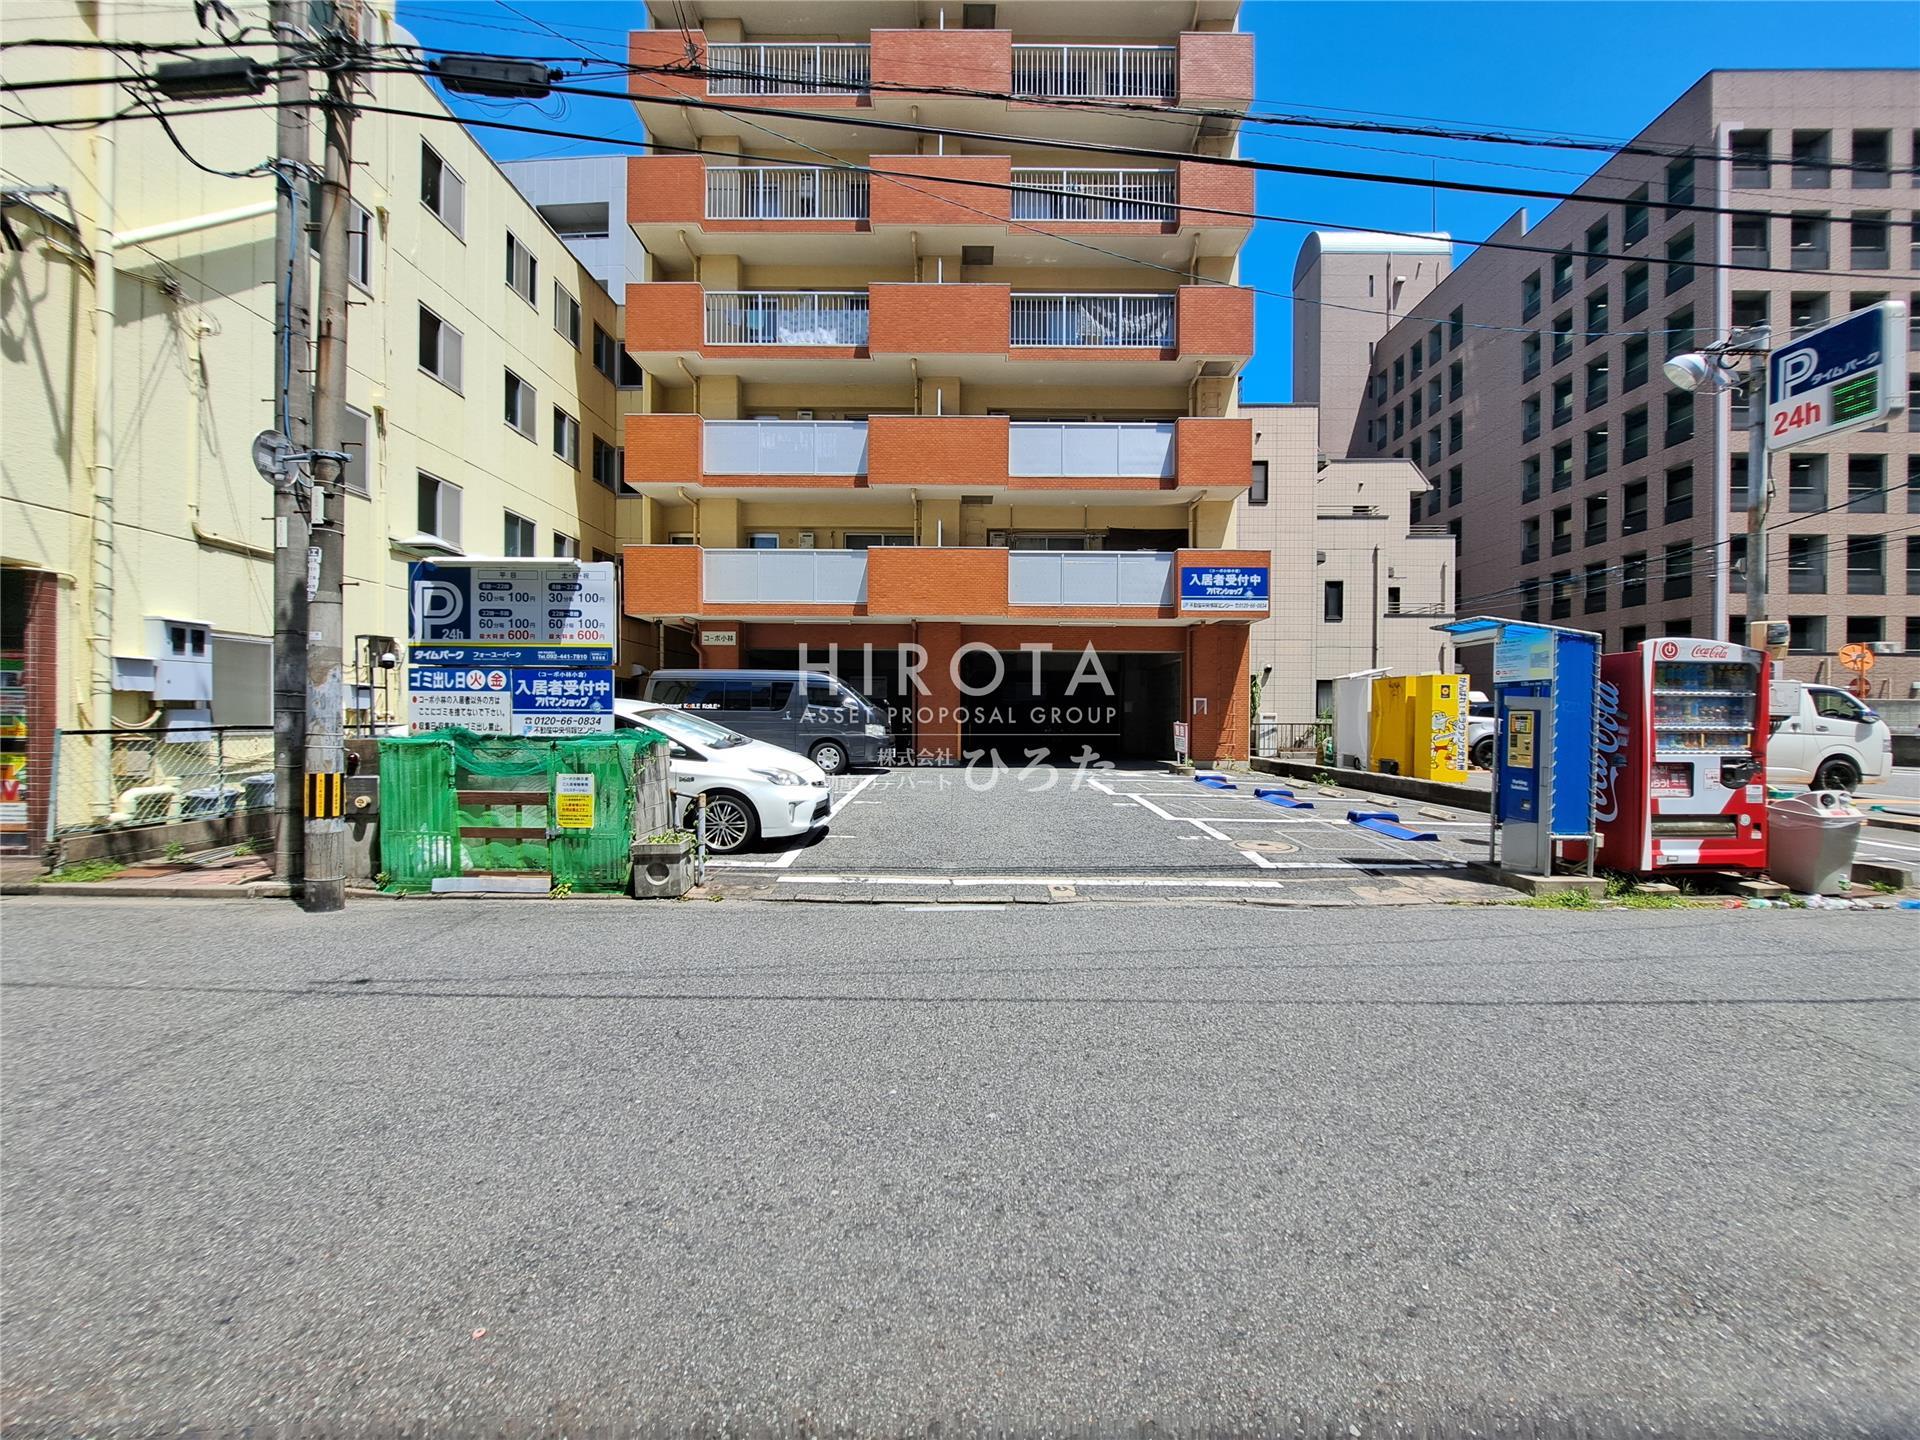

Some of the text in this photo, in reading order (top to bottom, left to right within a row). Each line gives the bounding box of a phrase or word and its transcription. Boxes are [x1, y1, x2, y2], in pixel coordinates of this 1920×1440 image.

[1810, 350, 1880, 386] タイムパーク
[1773, 401, 1821, 437] 24h
[1189, 574, 1261, 586] 入居者受付中
[1206, 587, 1244, 596] アパマンショップ
[508, 592, 535, 602] 100円
[578, 593, 605, 602] 100円
[508, 619, 535, 629] 100円
[578, 619, 605, 629] 100円
[441, 628, 464, 640] 24h
[508, 630, 535, 640] 600円
[577, 630, 605, 640] 600円
[414, 650, 465, 660] タイムパーク
[472, 651, 522, 659] フォーユーパーク
[410, 672, 504, 688] ゴミ出し日 火 金
[515, 680, 610, 696] 入居者受付中
[418, 696, 500, 704] コーポ小林の入居者以外の方は
[534, 697, 589, 708] アパマンショップ
[418, 708, 505, 717] ここにゴミを捨てないで下さい。
[534, 716, 602, 725] 0120-66-0834
[533, 726, 602, 736] 不動産中央情報センター
